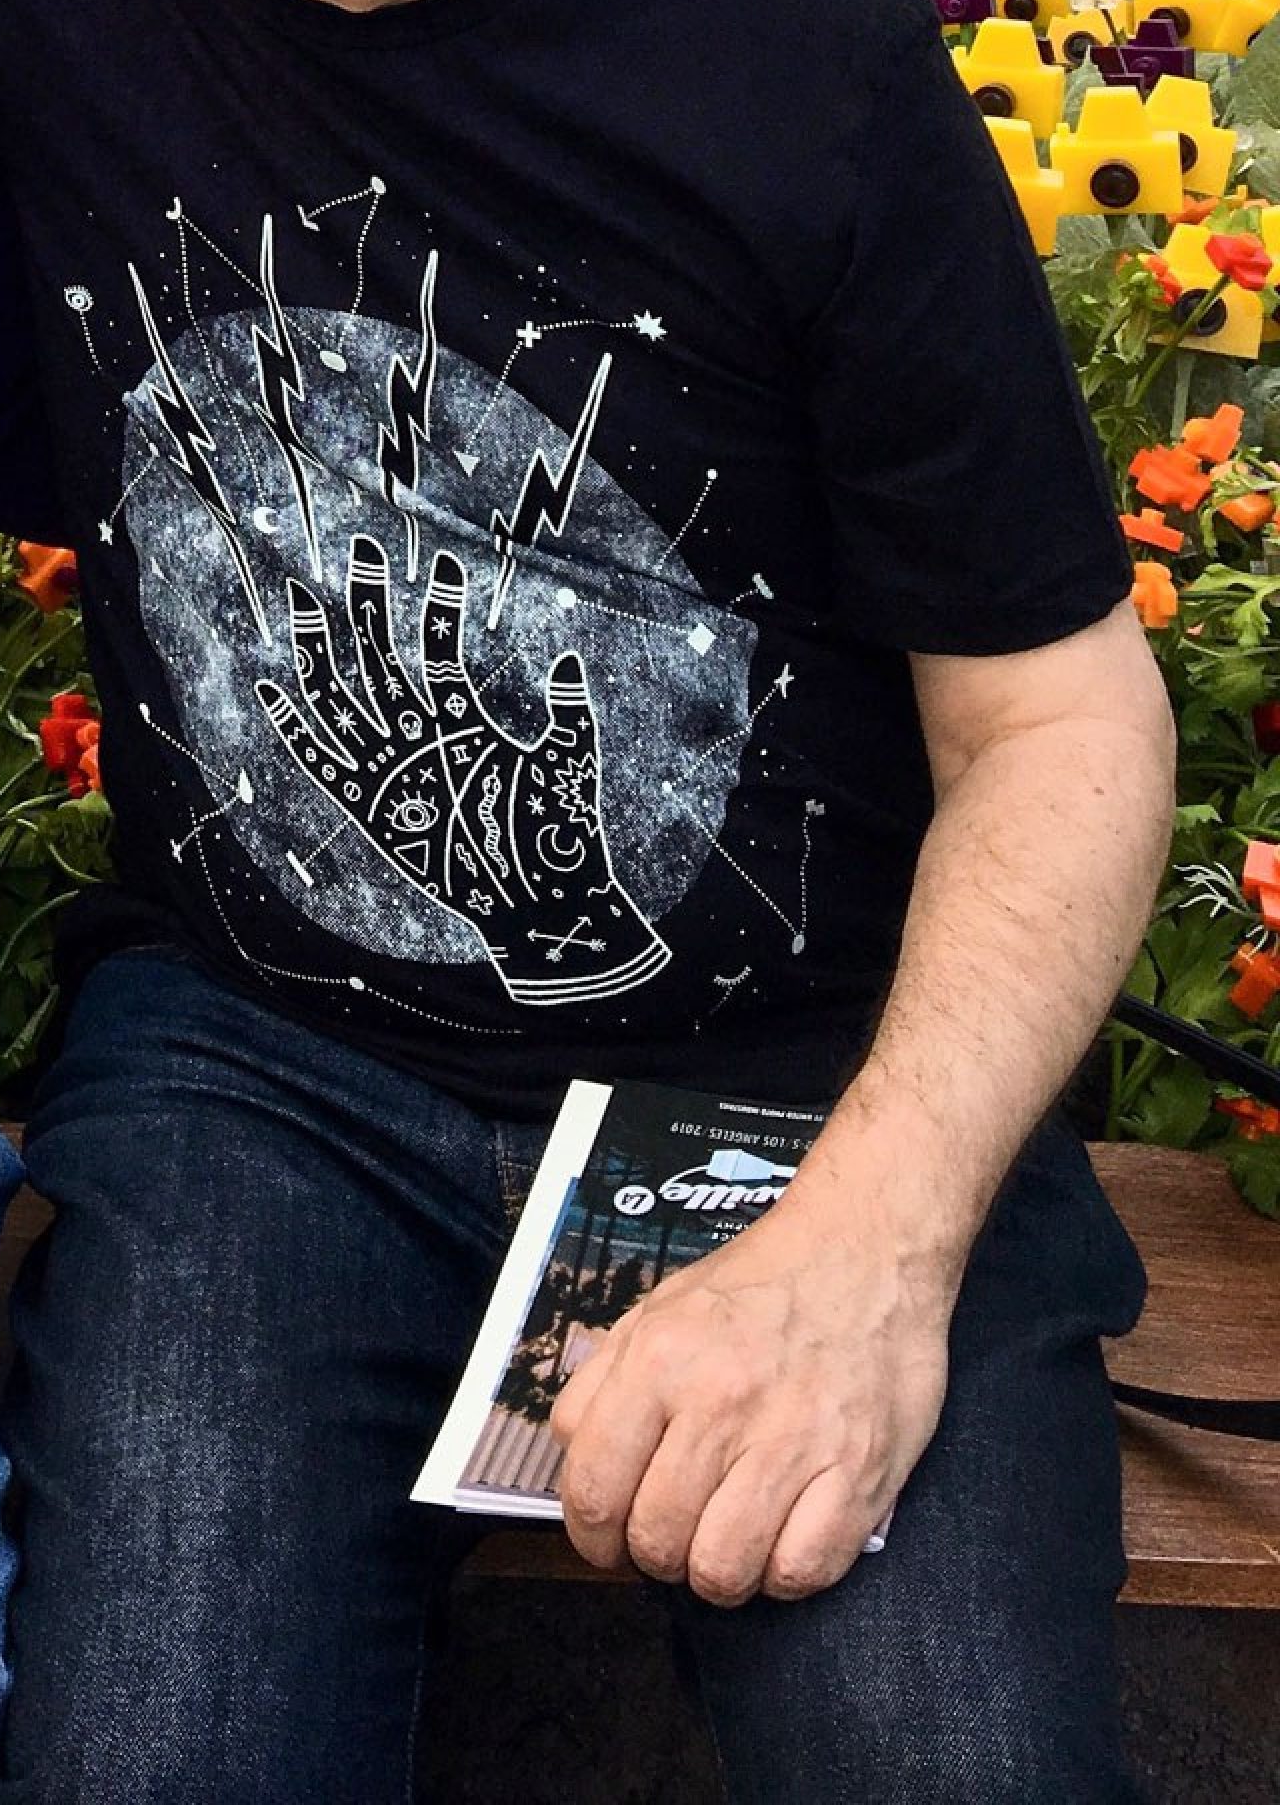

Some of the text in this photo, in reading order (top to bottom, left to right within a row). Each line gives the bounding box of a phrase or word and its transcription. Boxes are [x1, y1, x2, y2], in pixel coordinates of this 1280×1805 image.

[669, 1121, 702, 1137] 2019
[708, 1127, 761, 1145] ANGELES
[763, 1135, 786, 1148] LOS
